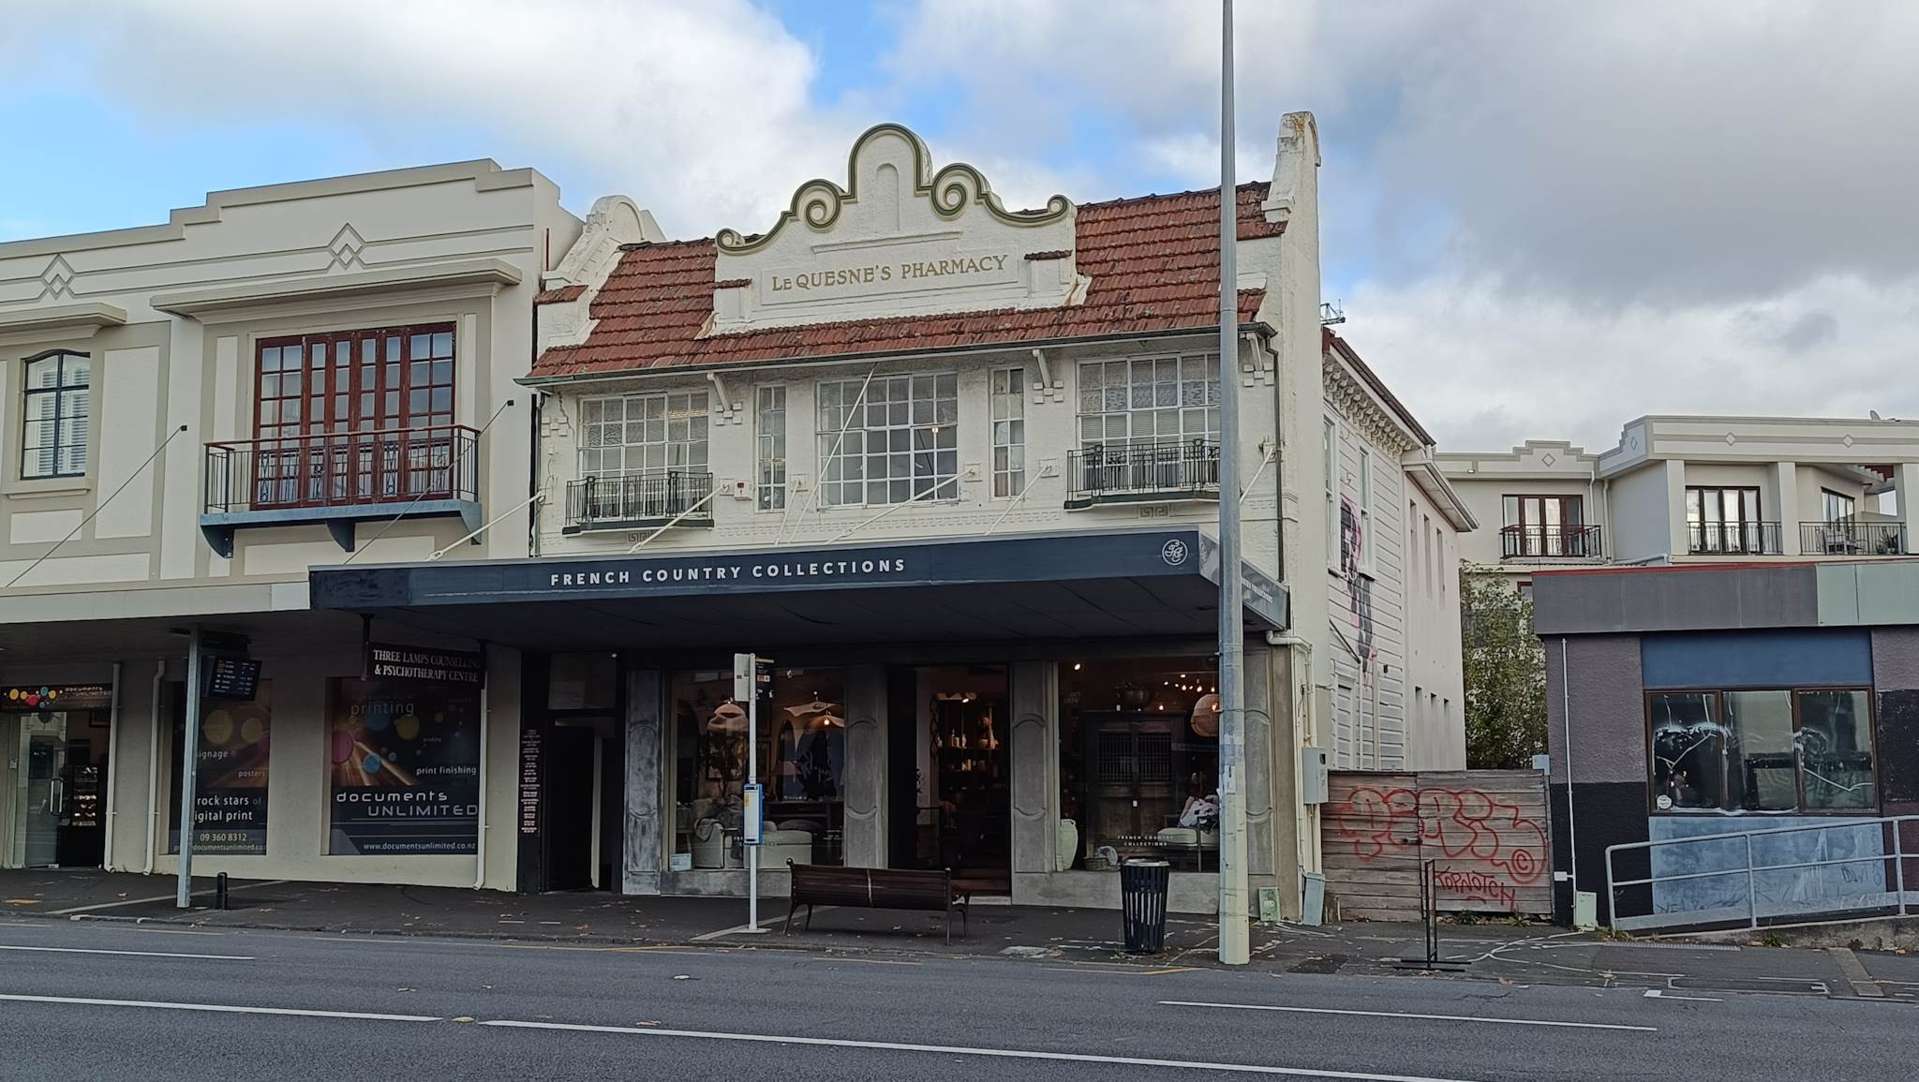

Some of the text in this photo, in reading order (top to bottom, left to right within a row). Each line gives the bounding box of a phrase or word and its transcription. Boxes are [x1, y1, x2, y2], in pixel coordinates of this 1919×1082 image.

[796, 265, 892, 290] QUESNE'S
[901, 254, 1009, 280] PHARMACY
[551, 559, 905, 587] FRENCH COUNTRY COLLECTIONS
[373, 649, 401, 662] THREE
[402, 652, 430, 665] LAMPS
[374, 663, 382, 676] &
[383, 664, 448, 681] PSYCHOTHERAPY
[350, 702, 415, 717] printing
[416, 765, 477, 776] print finishing
[197, 795, 220, 806] rock
[223, 797, 250, 806] stars
[336, 790, 448, 802] documents
[194, 809, 254, 824] igital print
[367, 804, 478, 817] UNLIMITED
[199, 832, 248, 842] 09 360 8312
[363, 841, 477, 851] www.documentsunlimited.co.nz
